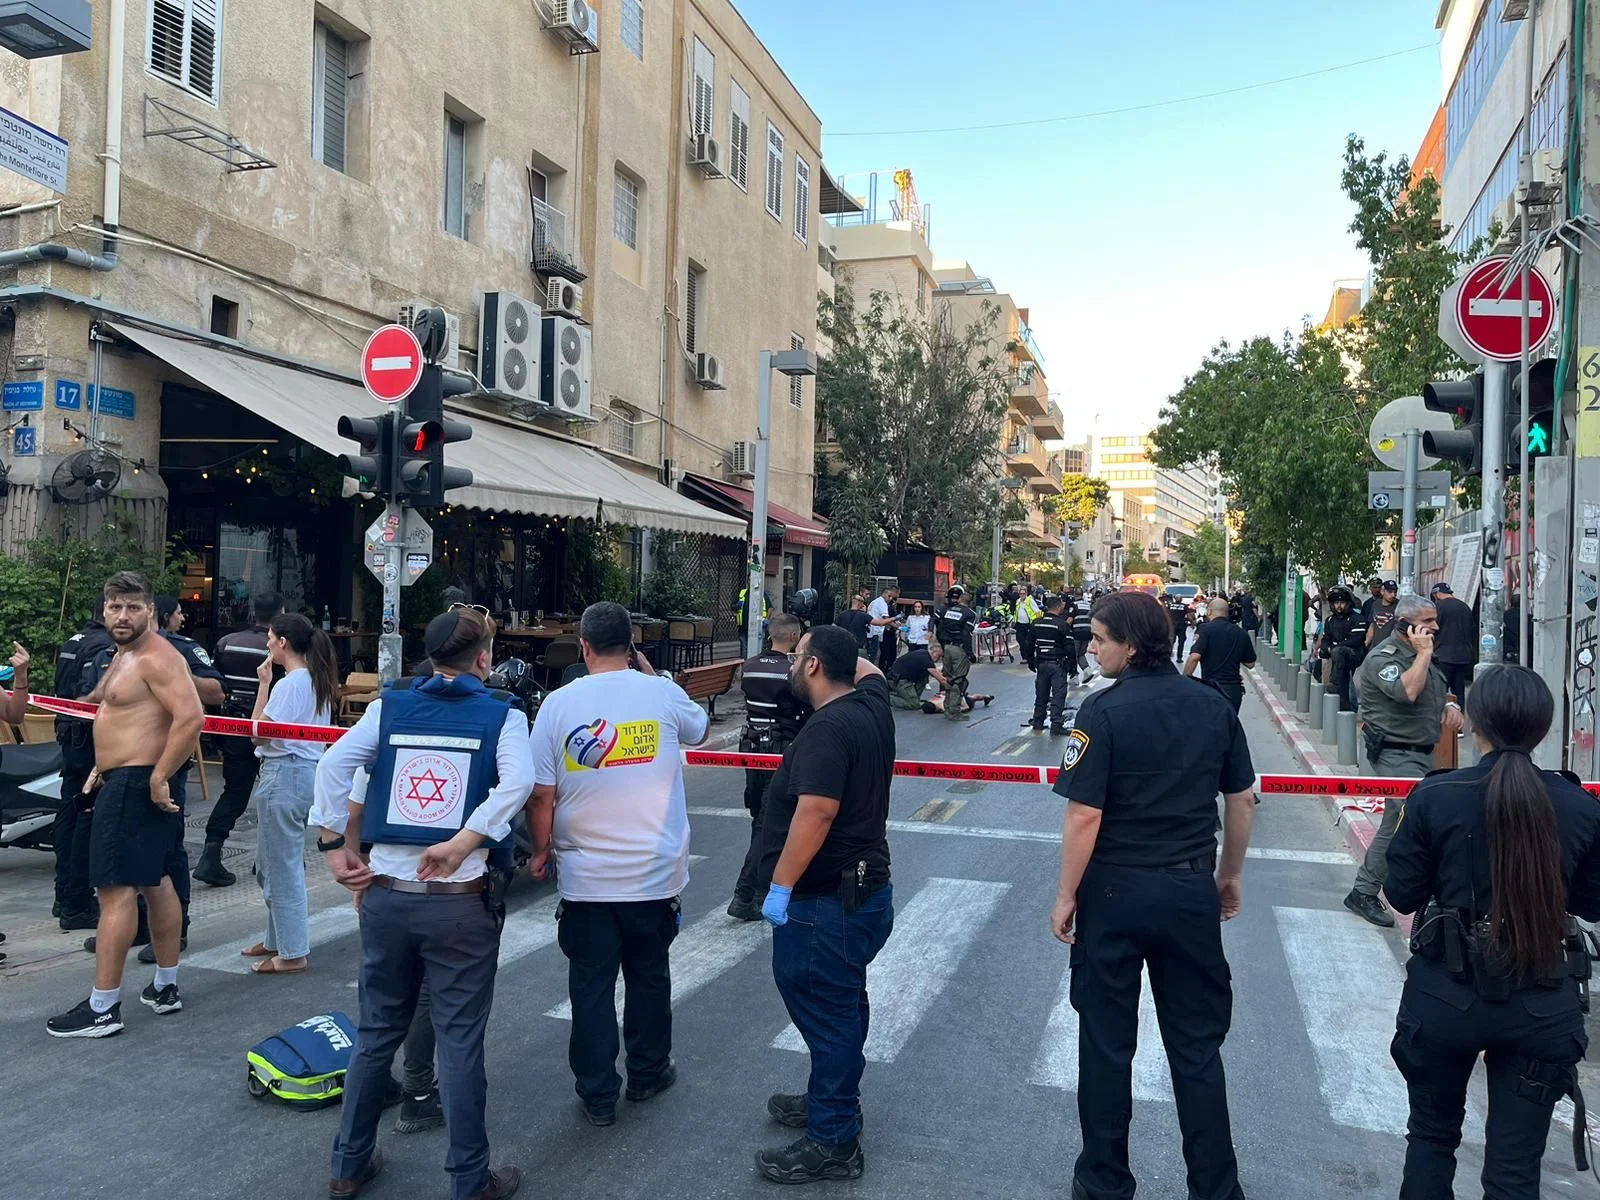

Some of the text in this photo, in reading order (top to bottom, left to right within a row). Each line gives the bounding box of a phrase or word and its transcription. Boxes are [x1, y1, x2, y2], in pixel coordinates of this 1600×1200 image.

[34, 135, 52, 150] משה
[9, 155, 49, 181] Montefiore
[59, 385, 78, 405] 17
[1583, 385, 1600, 411] 2
[16, 433, 32, 451] 45
[623, 723, 654, 736] מגן דוד
[633, 734, 655, 745] אדום
[621, 744, 656, 756] בישראל
[930, 766, 966, 778] ישראל
[991, 772, 1035, 781] משטרת
[1267, 782, 1399, 794] ישראל אין מעבר
[418, 811, 438, 820] ADOM
[437, 807, 446, 816] IN
[444, 788, 458, 810] ISRAEL
[94, 1013, 113, 1024] HOKA
[313, 1020, 349, 1052] ZAKA
